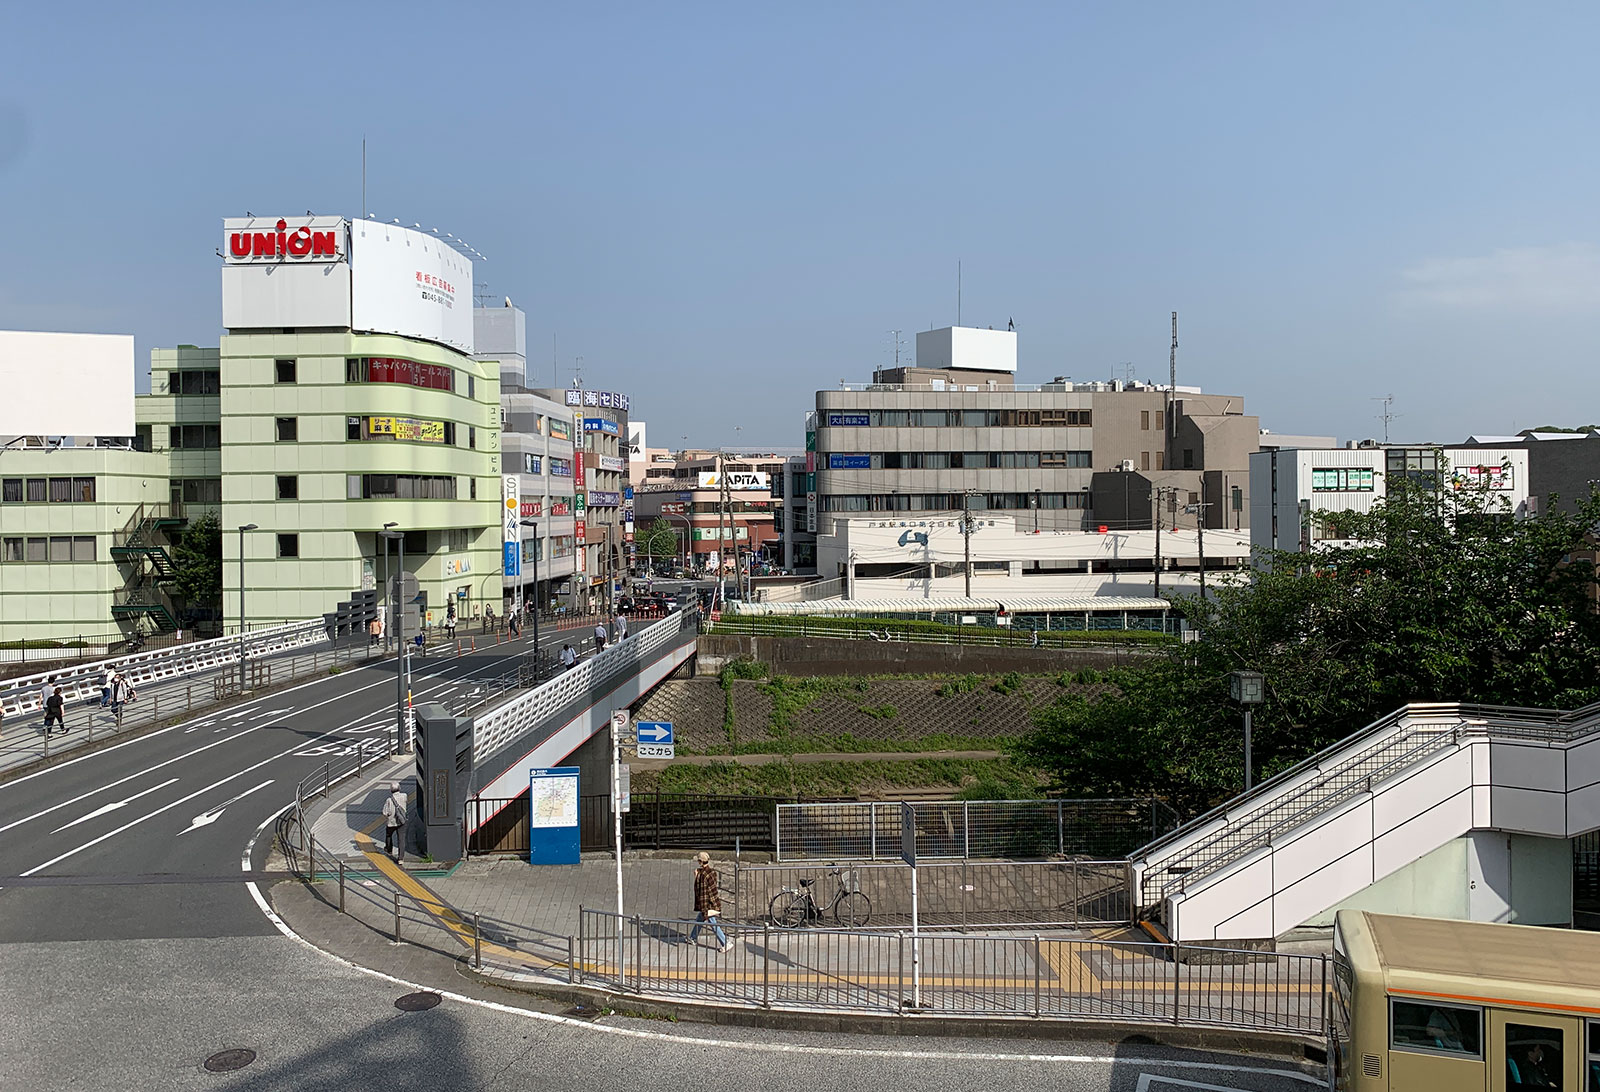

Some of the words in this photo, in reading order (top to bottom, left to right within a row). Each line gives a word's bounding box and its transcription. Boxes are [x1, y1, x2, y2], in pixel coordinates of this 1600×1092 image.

[414, 374, 425, 385] 5F
[639, 747, 672, 756] ここから
